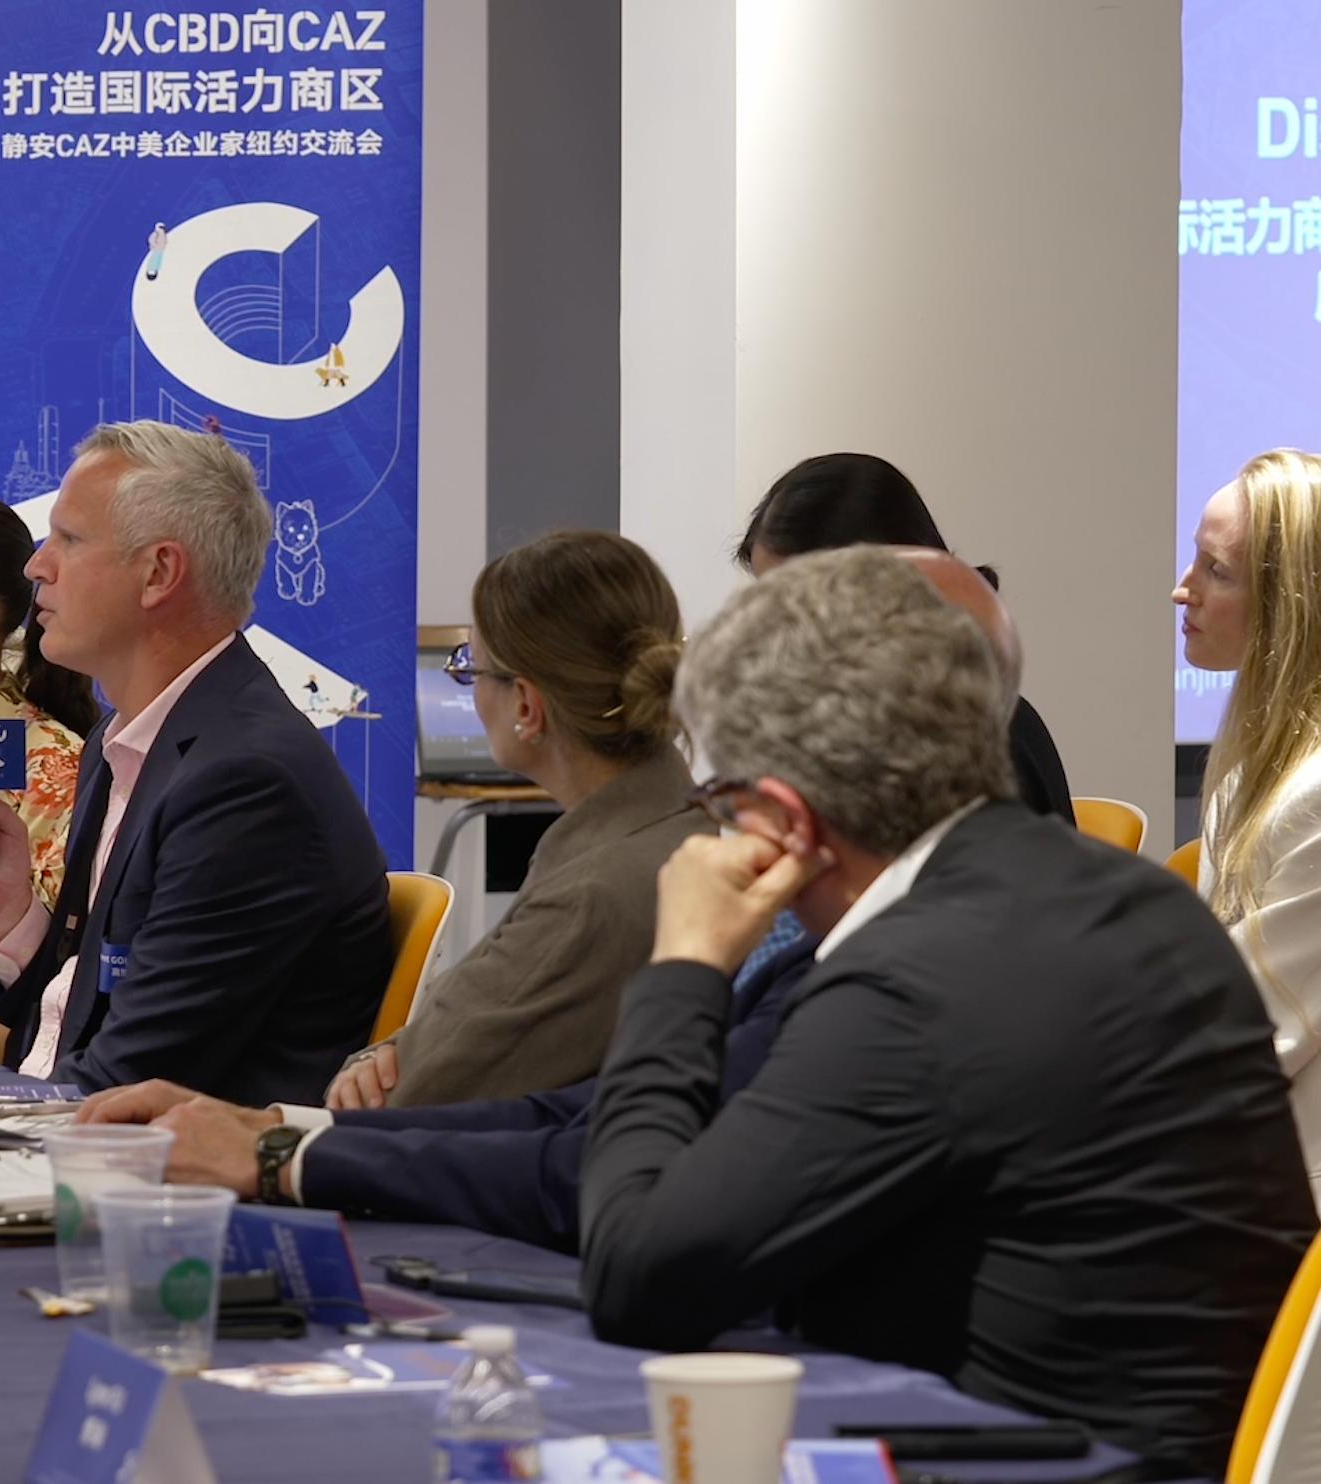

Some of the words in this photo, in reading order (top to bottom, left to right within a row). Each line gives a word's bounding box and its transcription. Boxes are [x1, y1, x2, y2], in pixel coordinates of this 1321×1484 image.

[97, 10, 387, 56] 从CBD向CAZ
[2, 67, 384, 117] 打造国际活力商区
[1, 129, 383, 160] 静安CAZ中美企业家纽约交流会
[1257, 97, 1321, 158] Di
